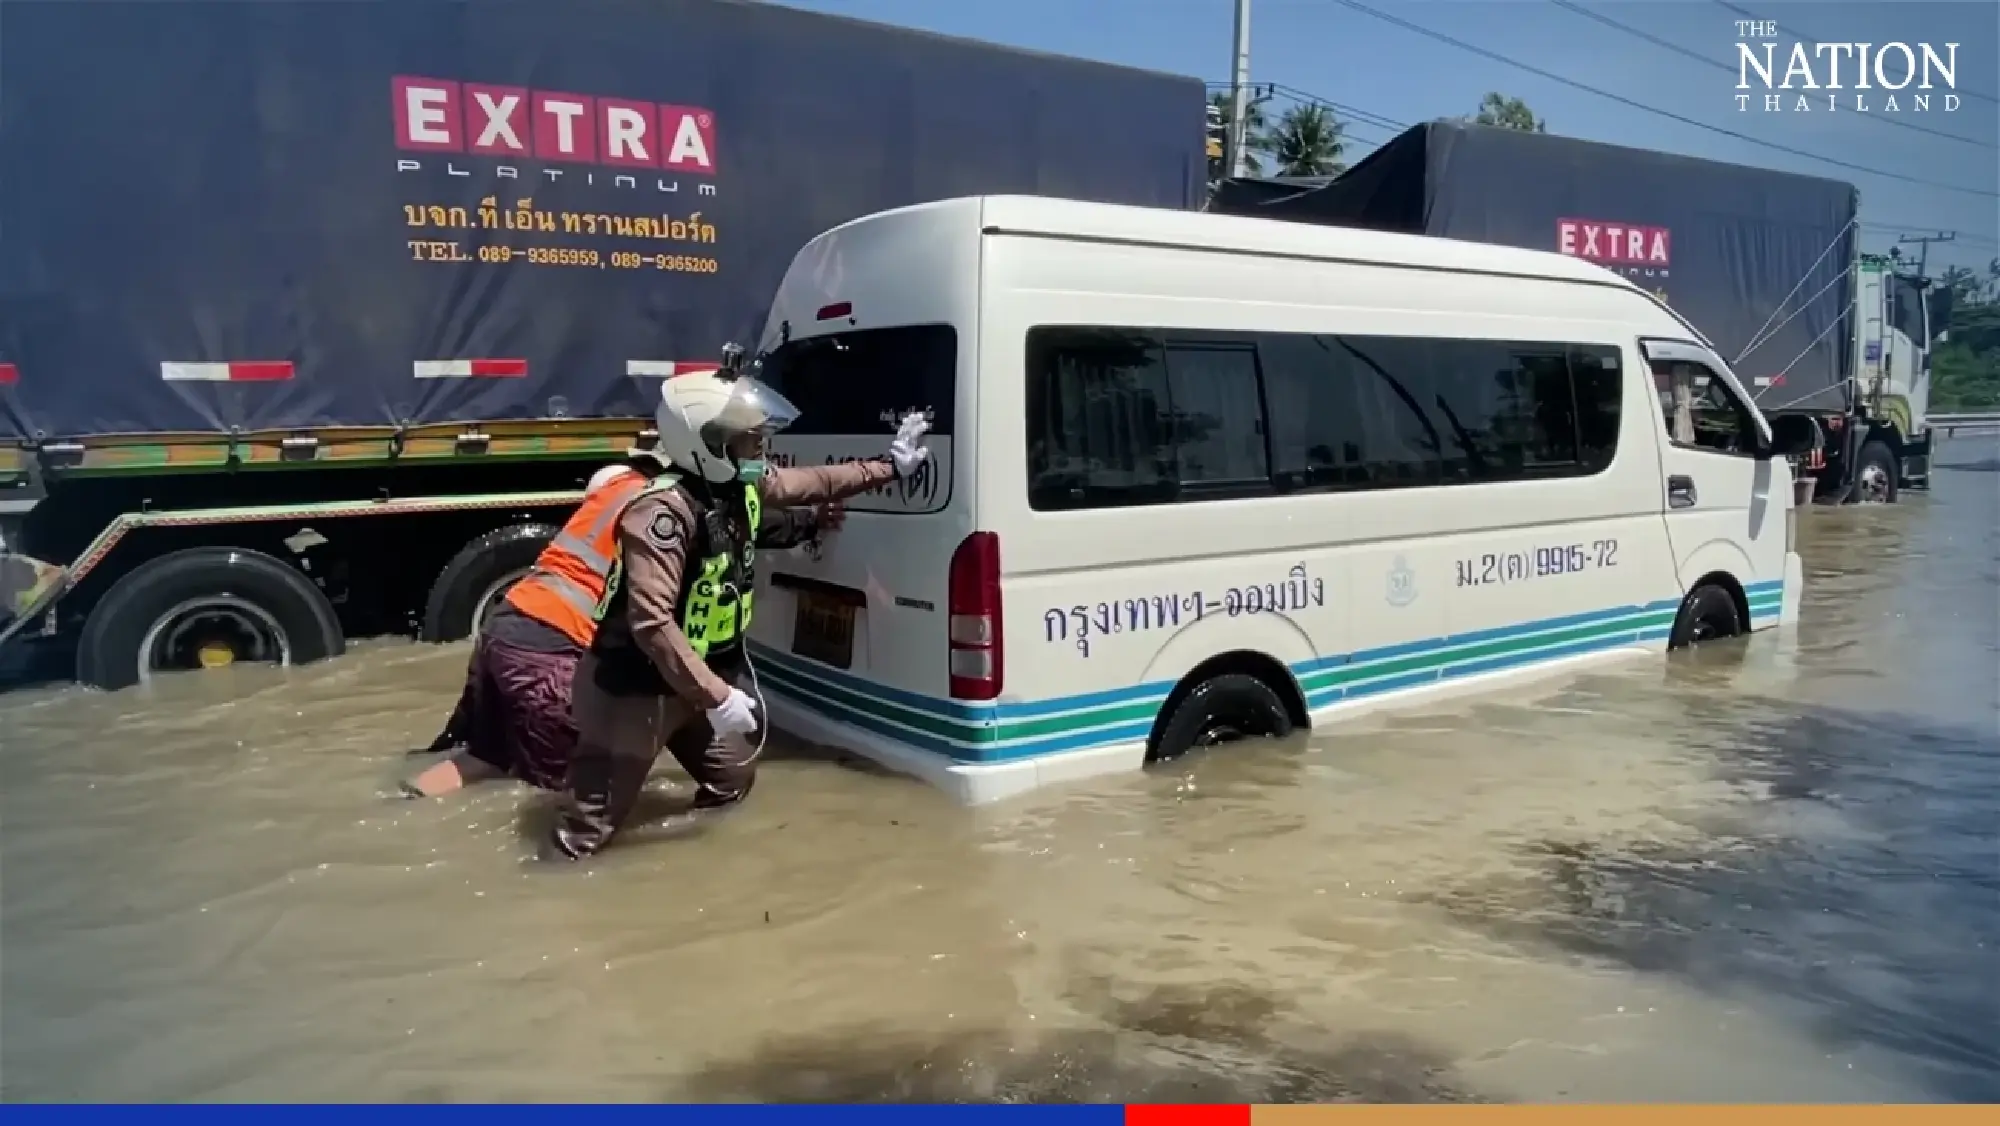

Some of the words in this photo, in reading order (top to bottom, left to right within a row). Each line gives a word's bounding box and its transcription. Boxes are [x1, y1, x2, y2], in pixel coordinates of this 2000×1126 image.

[406, 86, 712, 167] EXTRA
[407, 240, 475, 261] TEL.
[1561, 222, 1667, 261] EXTRA
